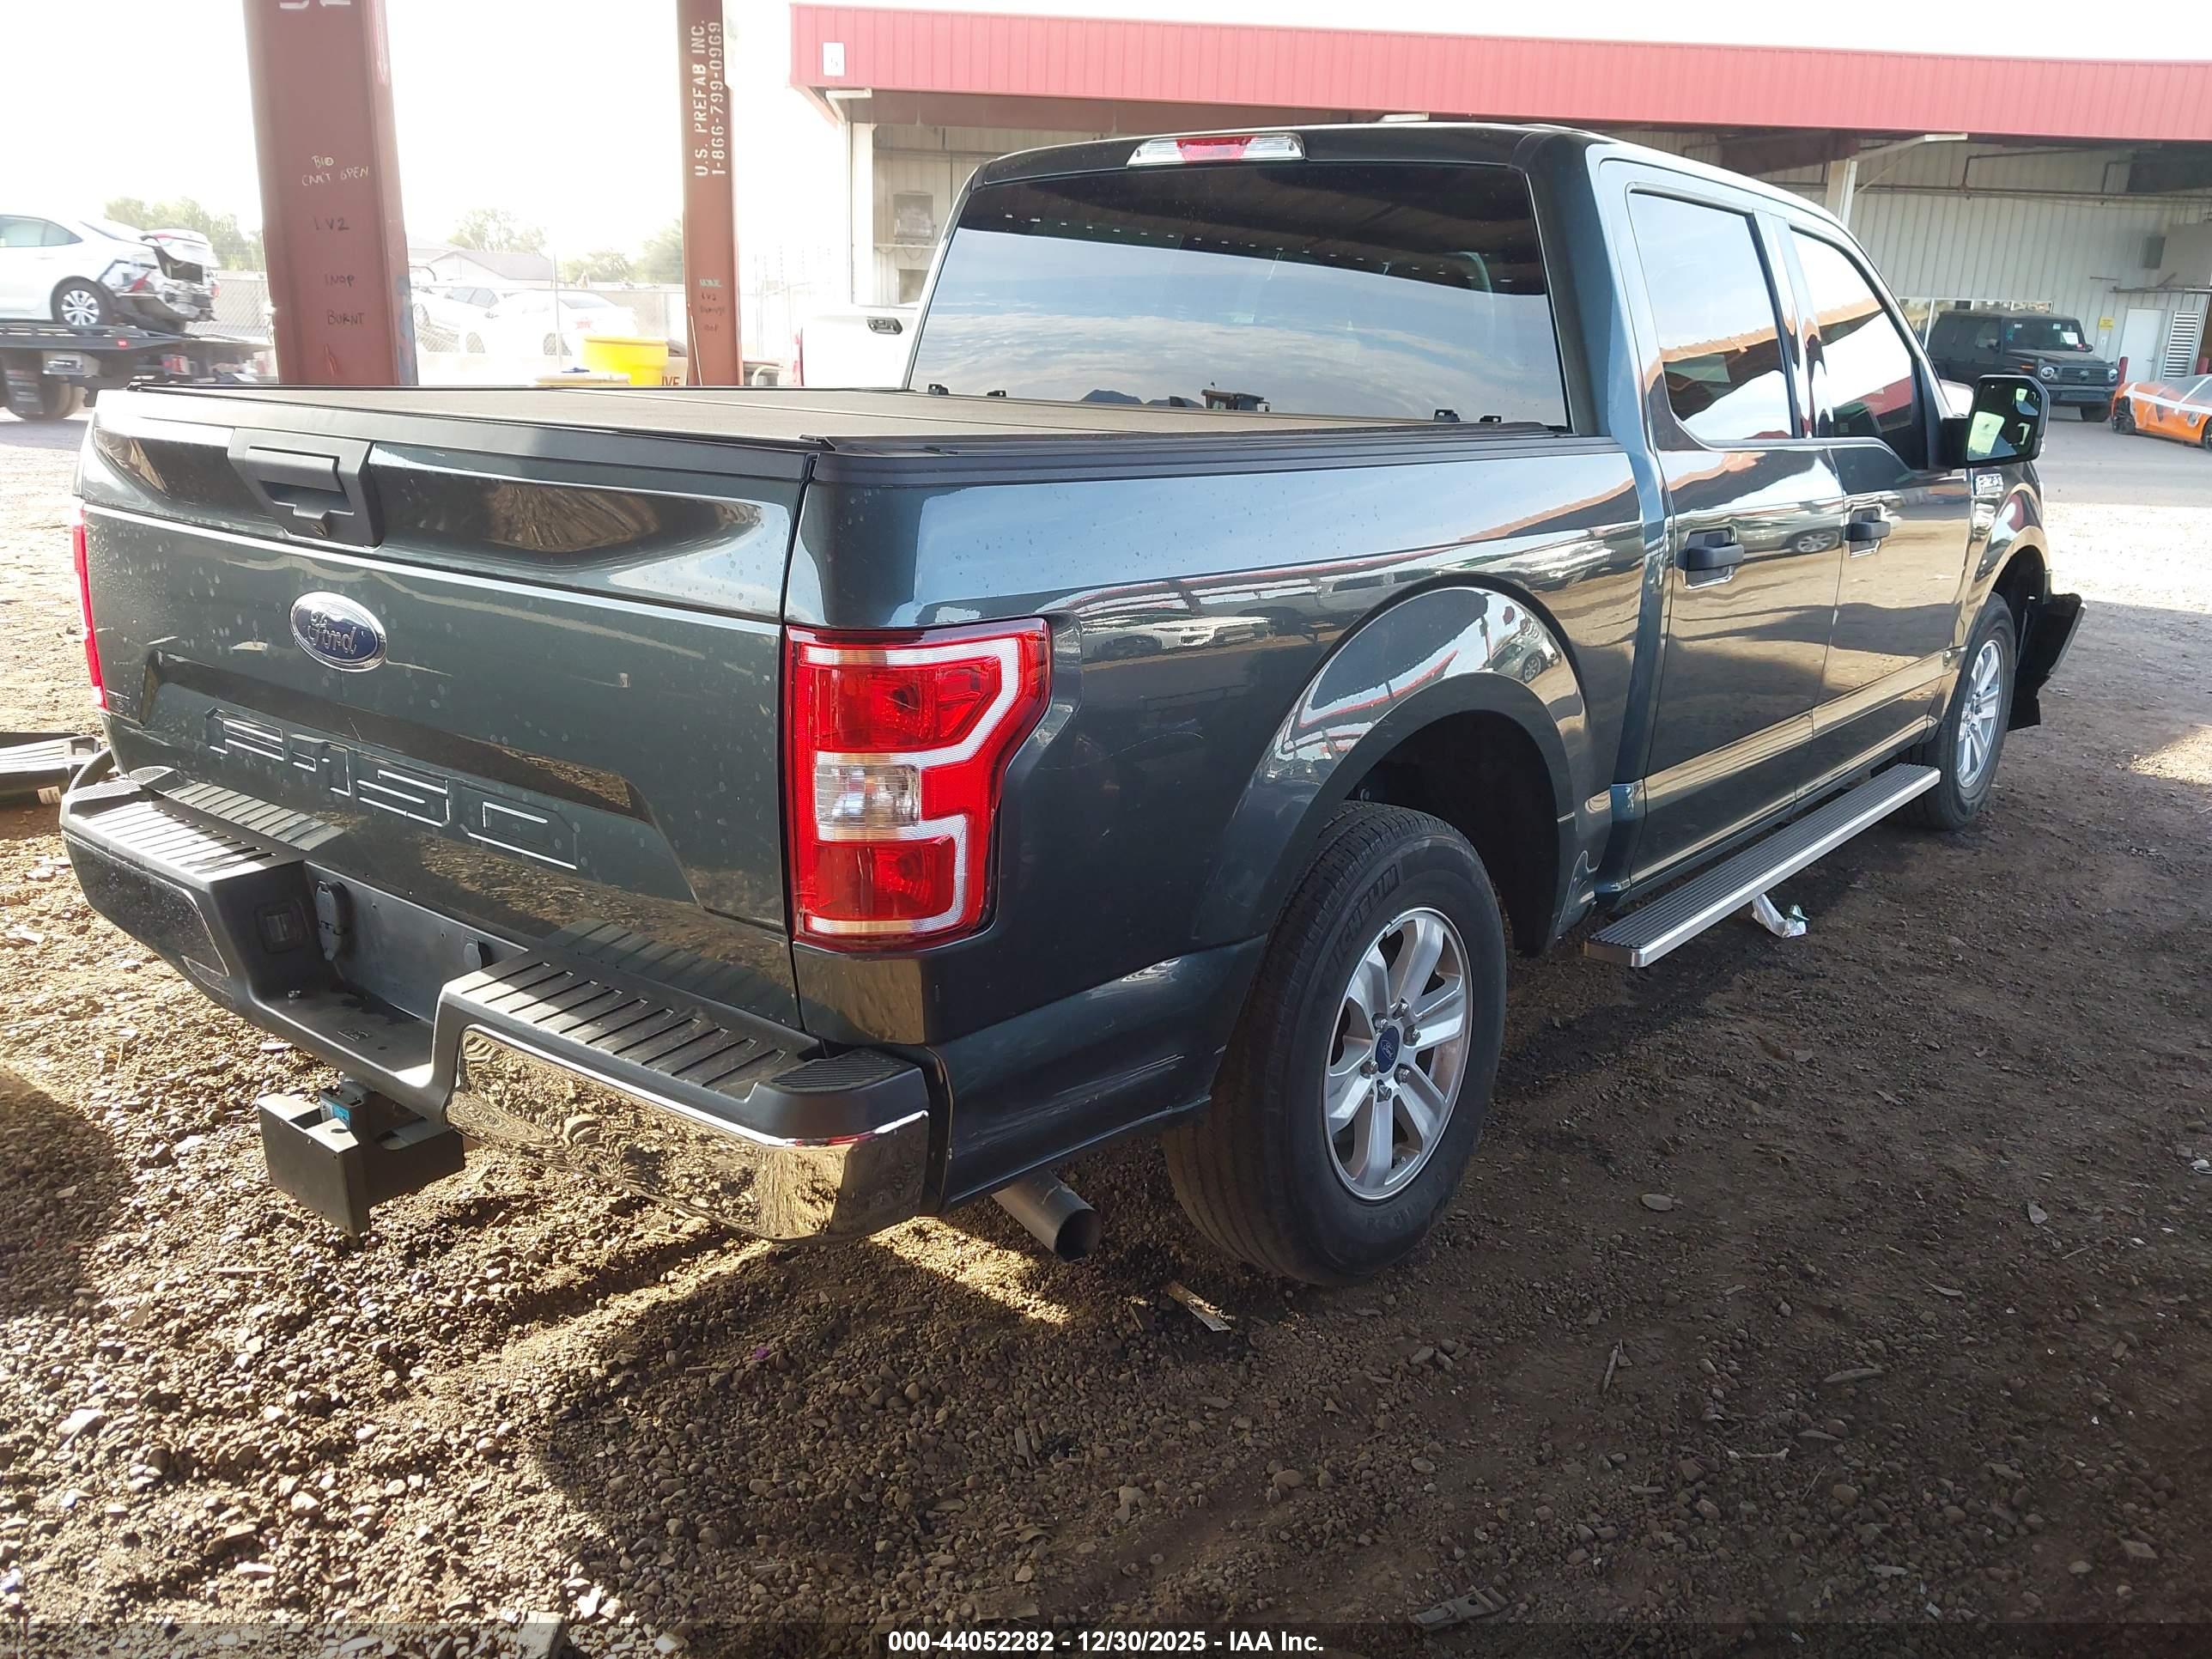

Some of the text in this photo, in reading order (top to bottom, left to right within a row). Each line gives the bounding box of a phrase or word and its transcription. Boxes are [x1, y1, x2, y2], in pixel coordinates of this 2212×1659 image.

[690, 19, 708, 177] U.S. PREFAB INC.
[708, 21, 726, 176] 1-866-799-0969
[340, 166, 369, 180] OPEN
[327, 310, 365, 325] BURNT
[307, 610, 358, 656] Ford
